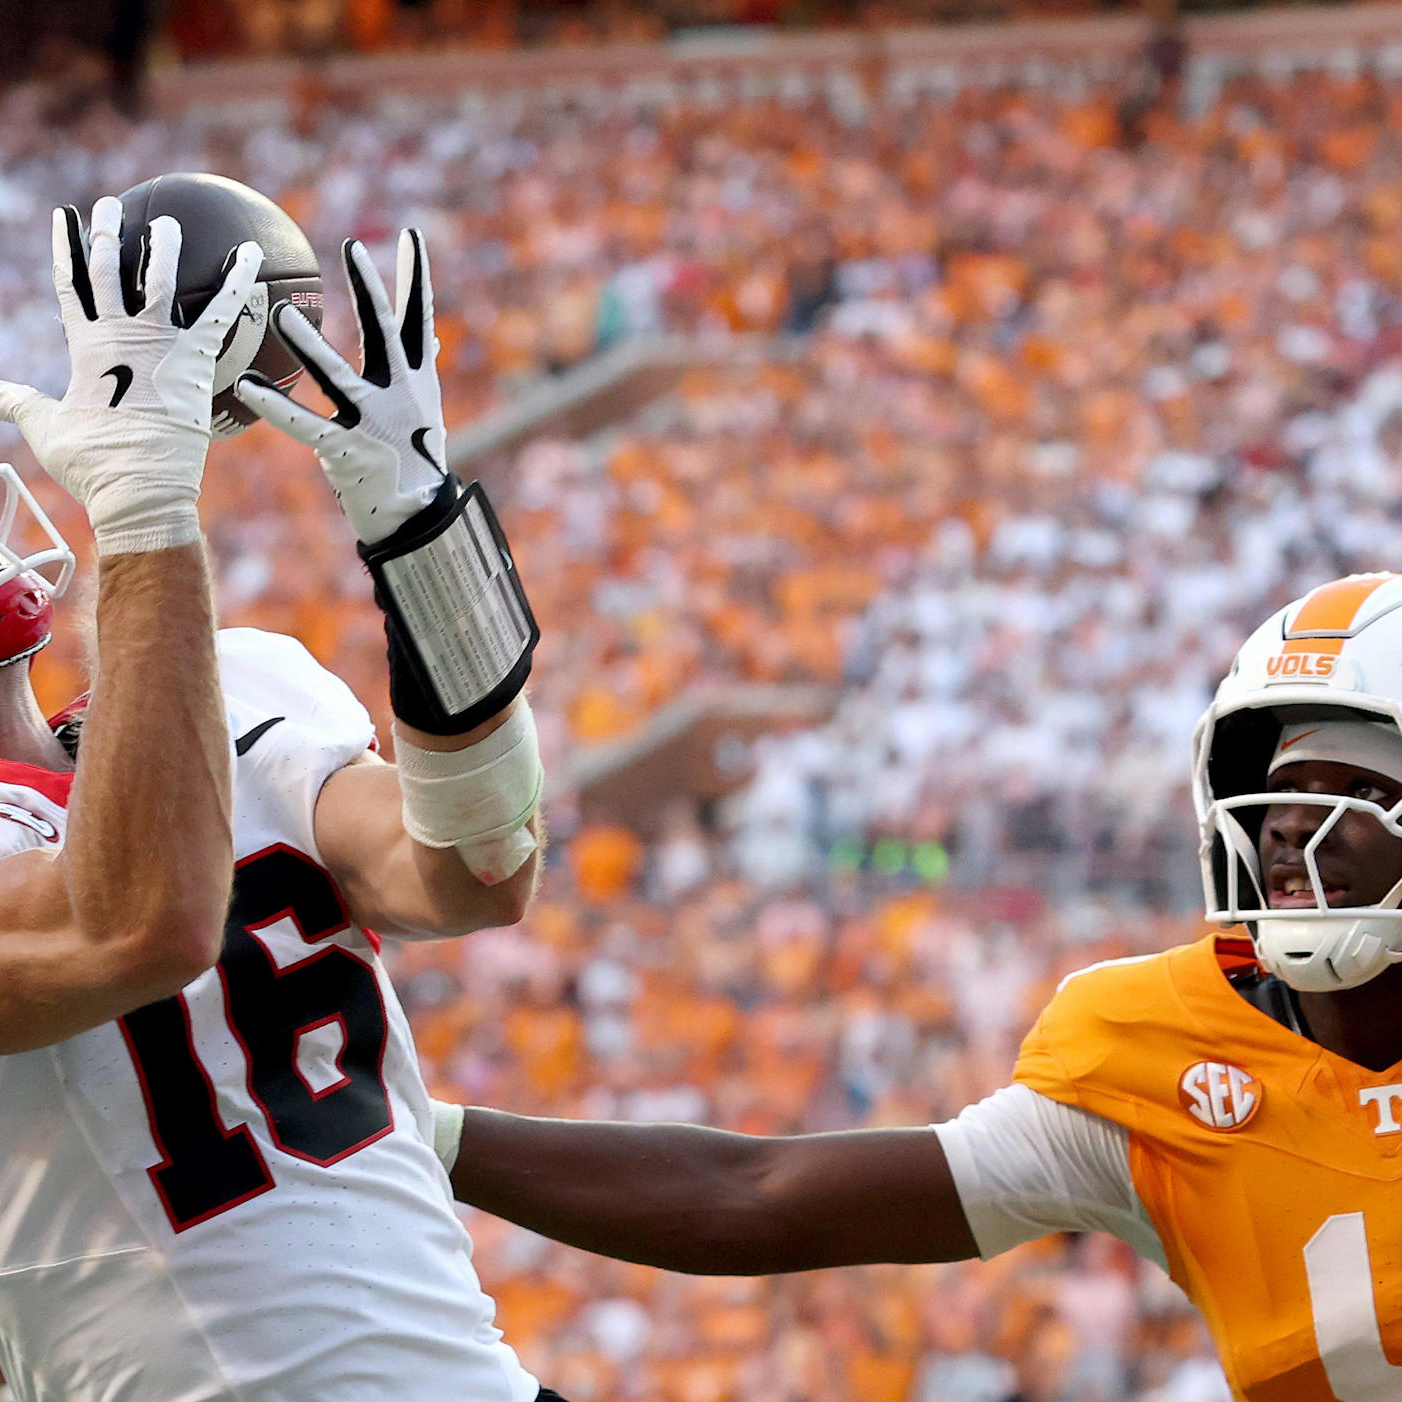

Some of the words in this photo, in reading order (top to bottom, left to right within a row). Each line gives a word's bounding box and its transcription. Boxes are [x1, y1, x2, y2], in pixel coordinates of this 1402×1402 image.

[1266, 655, 1336, 676] VOLS
[117, 841, 395, 1235] 16
[1181, 1060, 1256, 1128] SEC
